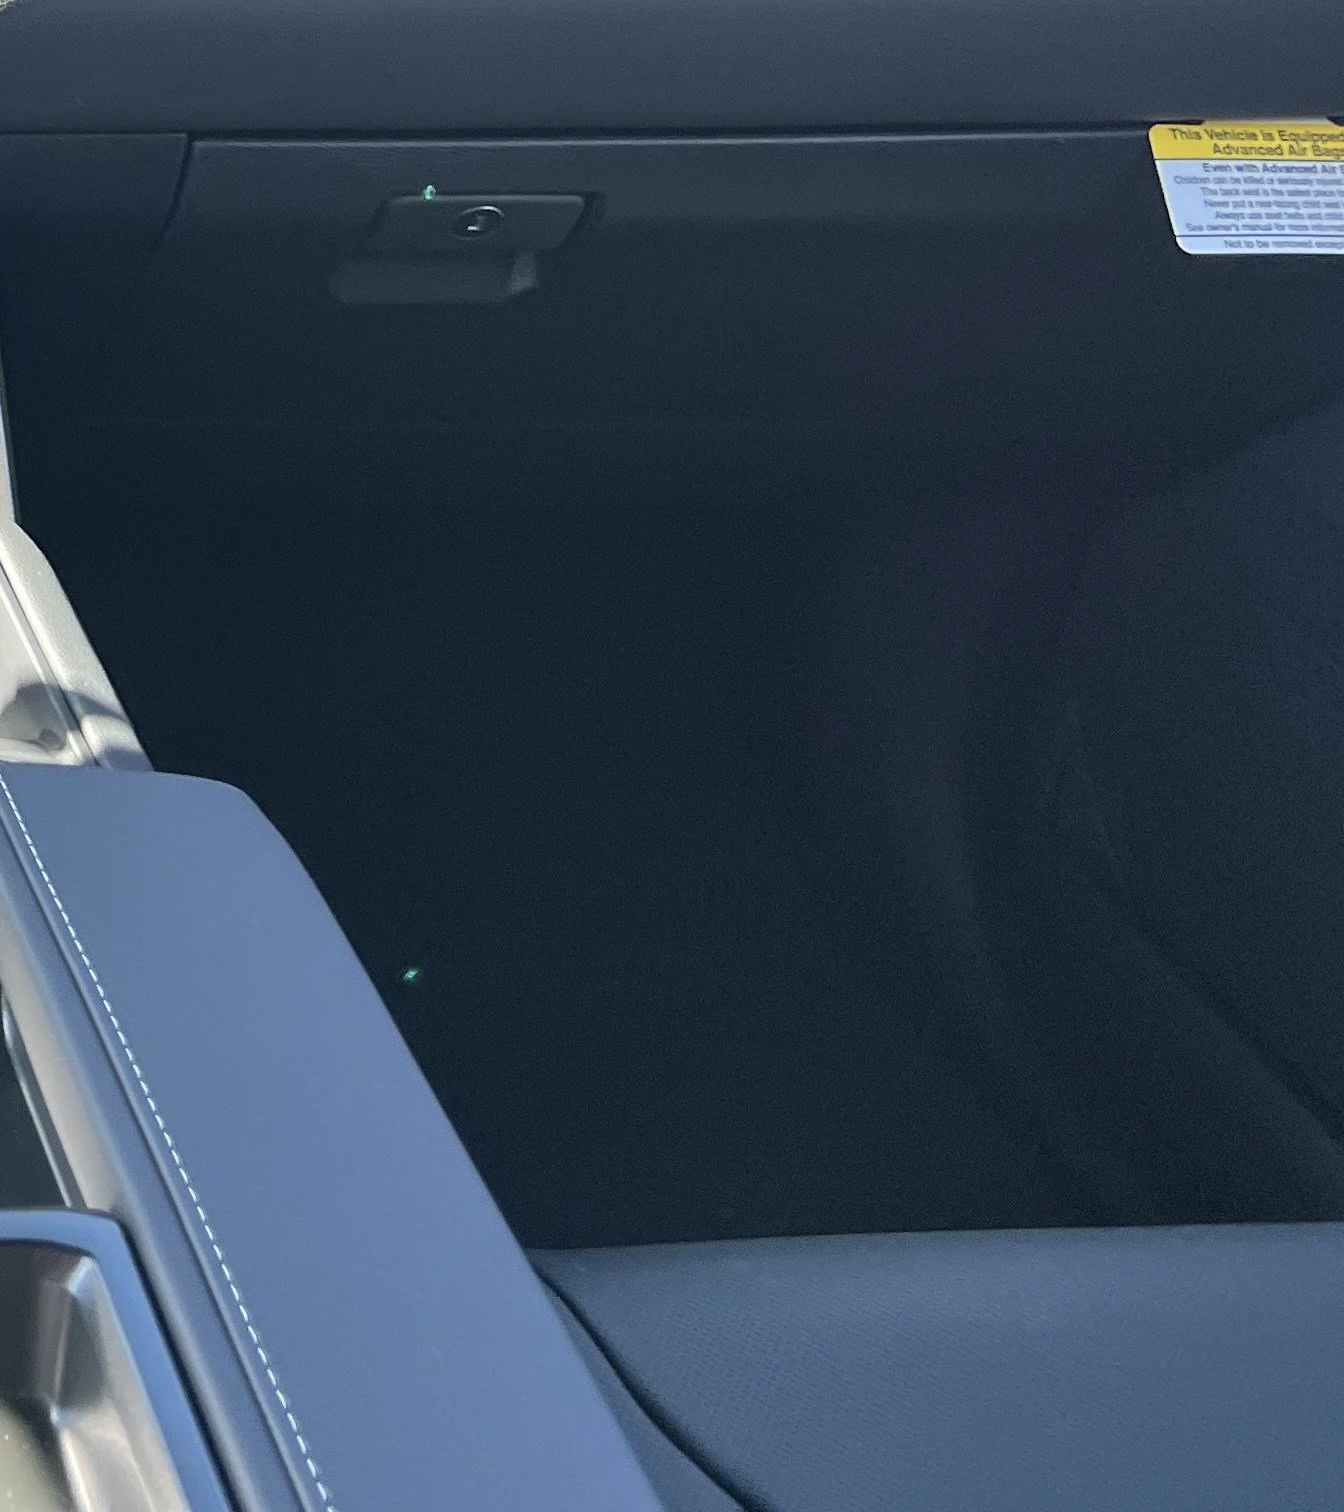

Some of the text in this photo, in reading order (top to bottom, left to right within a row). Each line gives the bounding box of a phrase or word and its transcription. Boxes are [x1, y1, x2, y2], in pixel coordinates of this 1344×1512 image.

[1170, 128, 1202, 141] This
[1204, 128, 1258, 142] Vehicle
[1213, 143, 1284, 157] Advanced
[1288, 144, 1307, 157] Air
